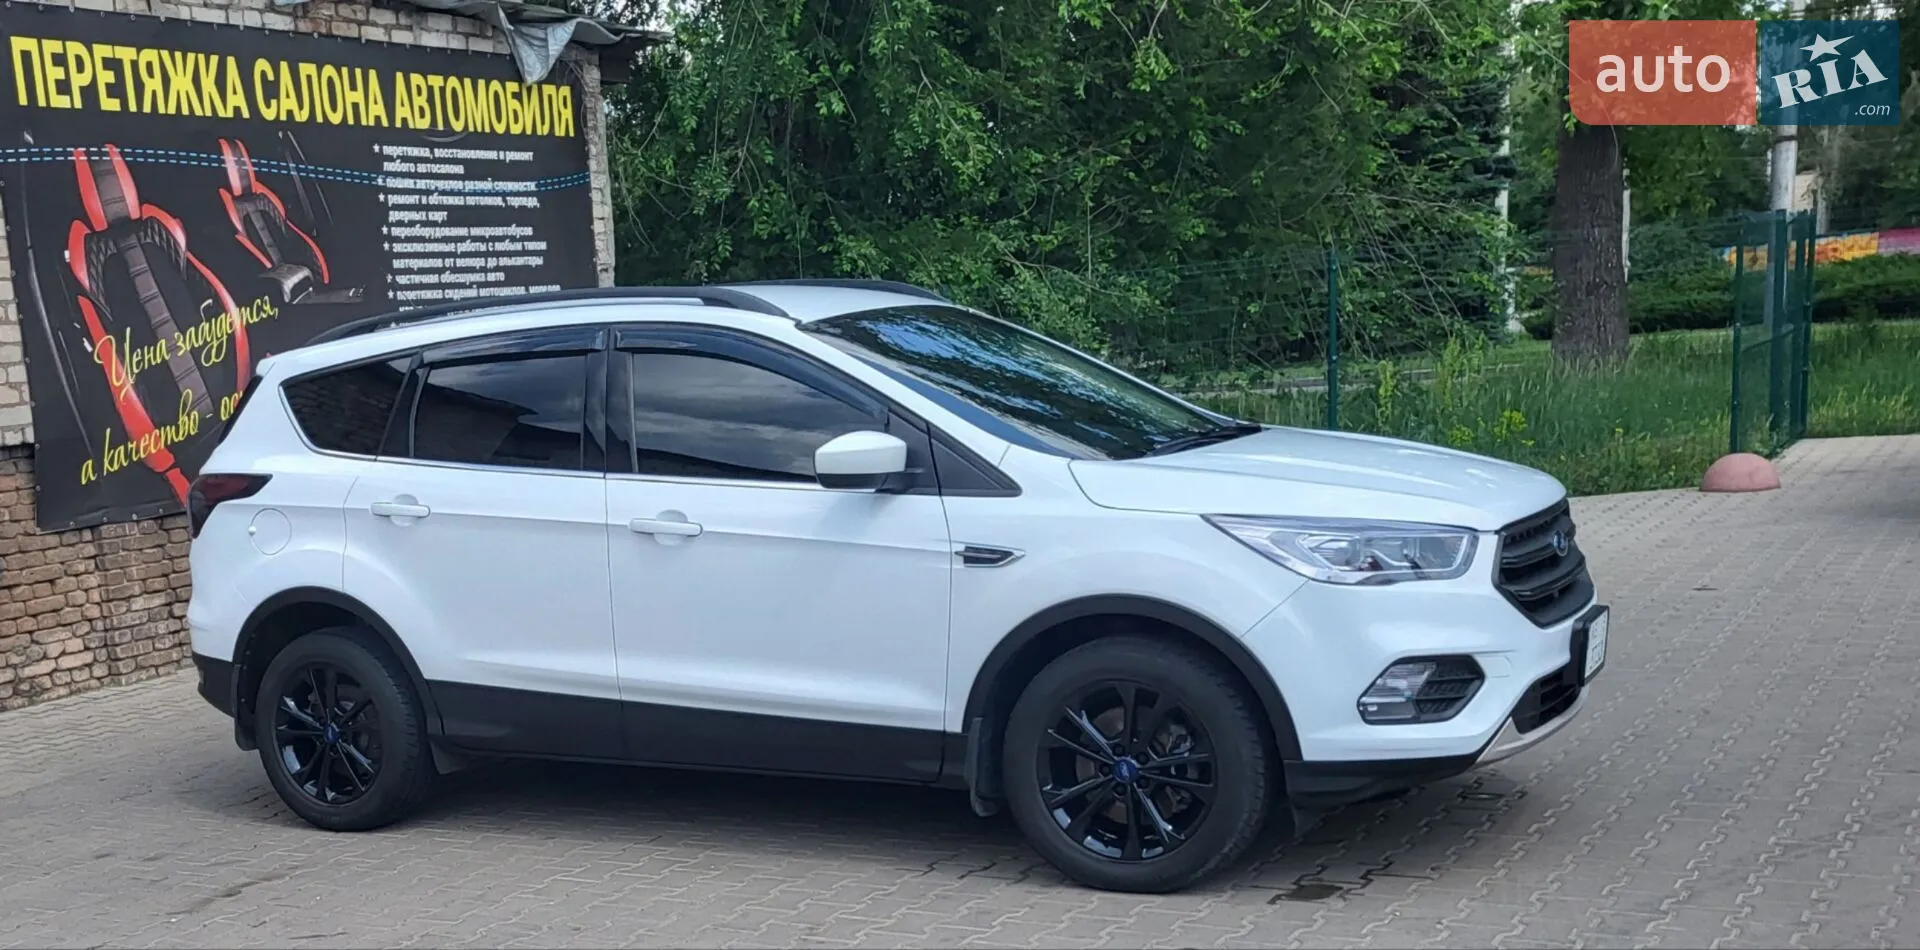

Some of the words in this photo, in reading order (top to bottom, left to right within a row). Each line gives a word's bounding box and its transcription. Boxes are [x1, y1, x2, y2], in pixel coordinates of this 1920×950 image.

[10, 36, 250, 118] ПЕРЕТЯЖКА
[253, 57, 389, 127] САЛОНА
[395, 71, 575, 137] АВТОМОБИЛЯ
[382, 145, 432, 159] перетяжка,
[434, 148, 498, 160] восстановление
[499, 150, 505, 160] и
[506, 151, 533, 163] ремонт
[383, 160, 415, 173] любого
[417, 163, 464, 174] автосалона
[388, 194, 420, 207] ремонт
[421, 195, 427, 204] и
[428, 192, 465, 205] обтяжка
[389, 211, 427, 222] дверных
[428, 211, 448, 223] карт
[391, 226, 468, 239] переоборудование
[470, 225, 533, 239] микроавтобусов
[393, 242, 455, 252] эксклюзивные
[457, 240, 486, 254] работы
[488, 242, 493, 251] с
[495, 239, 522, 251] любым
[524, 241, 547, 250] типом
[393, 258, 443, 270] материалов
[445, 258, 454, 268] от
[456, 257, 485, 269] велюра
[487, 257, 497, 268] до
[499, 256, 543, 268] алькантары
[395, 273, 439, 284] частичная
[441, 270, 485, 285] обесшумка
[487, 271, 505, 281] авто
[444, 284, 478, 301] сидений
[94, 327, 170, 405] Цена
[175, 296, 279, 367] забудется,
[81, 458, 97, 485] а
[103, 388, 199, 476] качество
